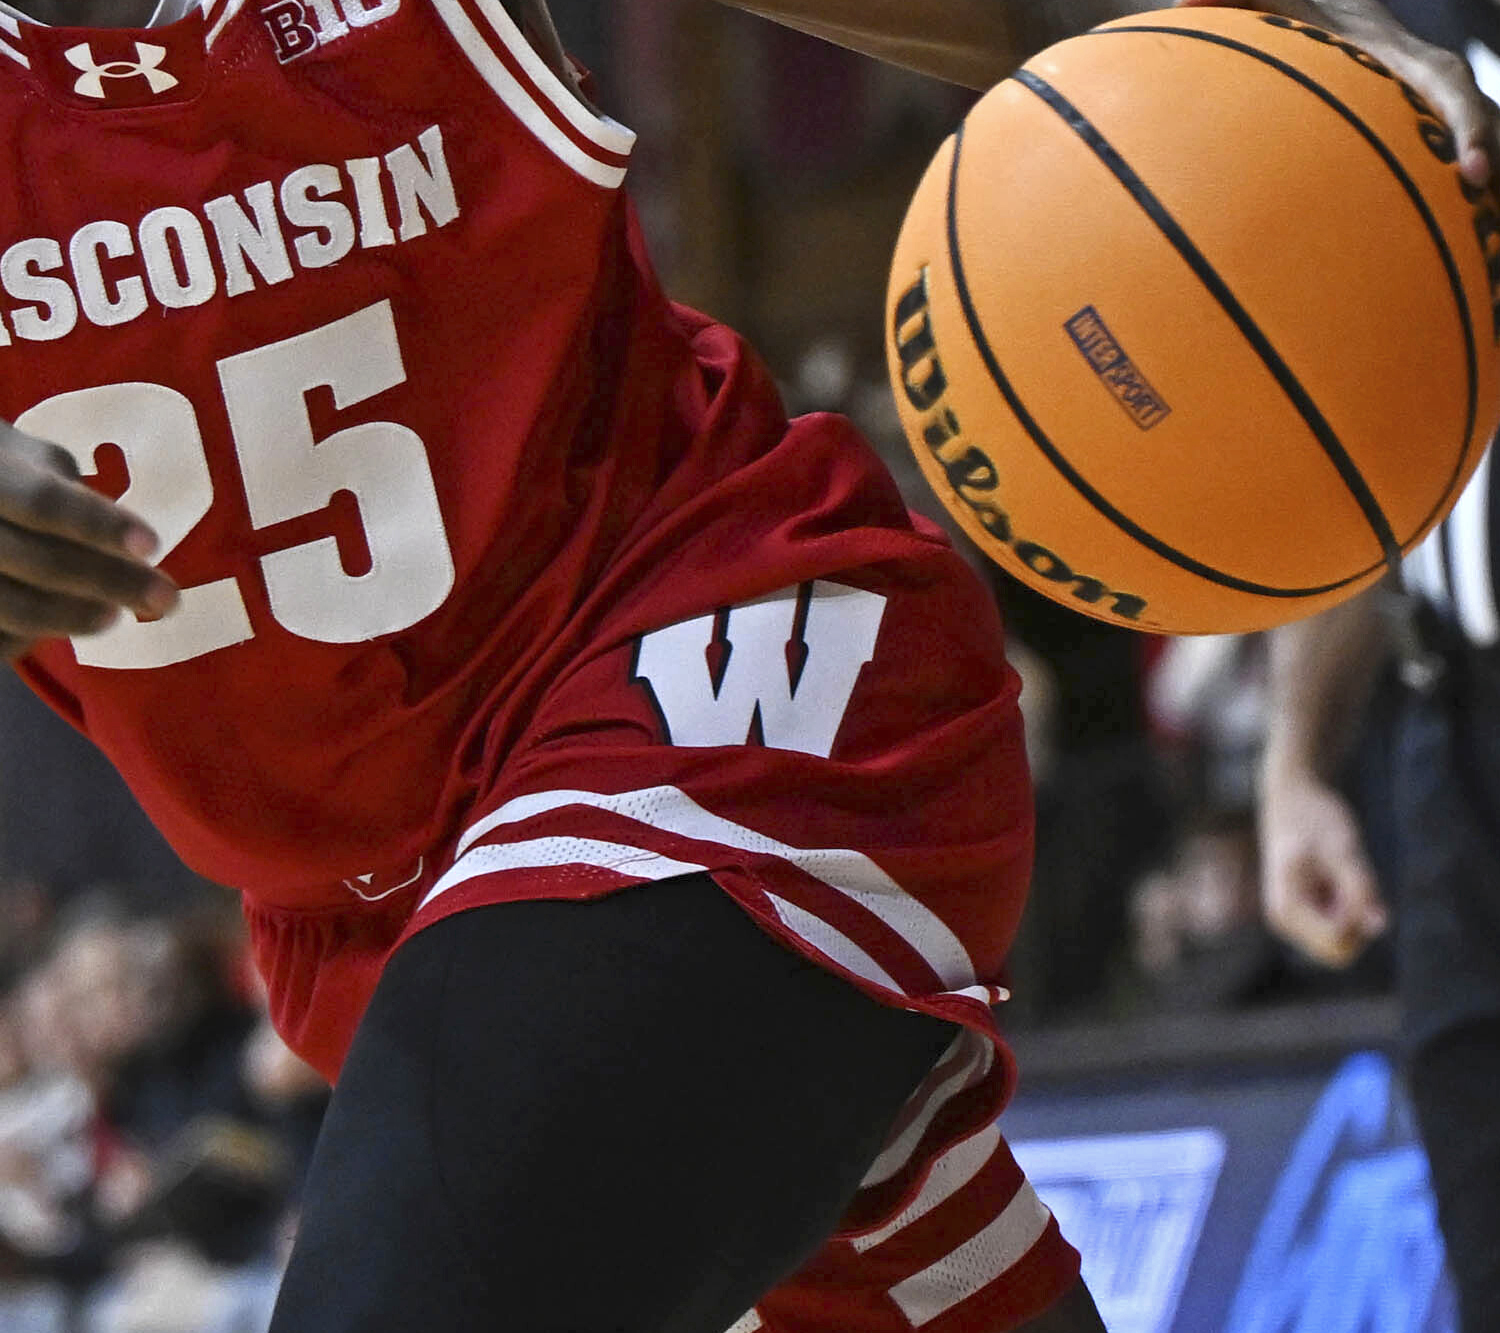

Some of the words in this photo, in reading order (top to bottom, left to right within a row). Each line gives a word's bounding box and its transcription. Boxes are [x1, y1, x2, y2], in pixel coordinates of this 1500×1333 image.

[11, 298, 456, 670] 25
[894, 262, 1148, 621] Wilson
[630, 579, 888, 759] W
